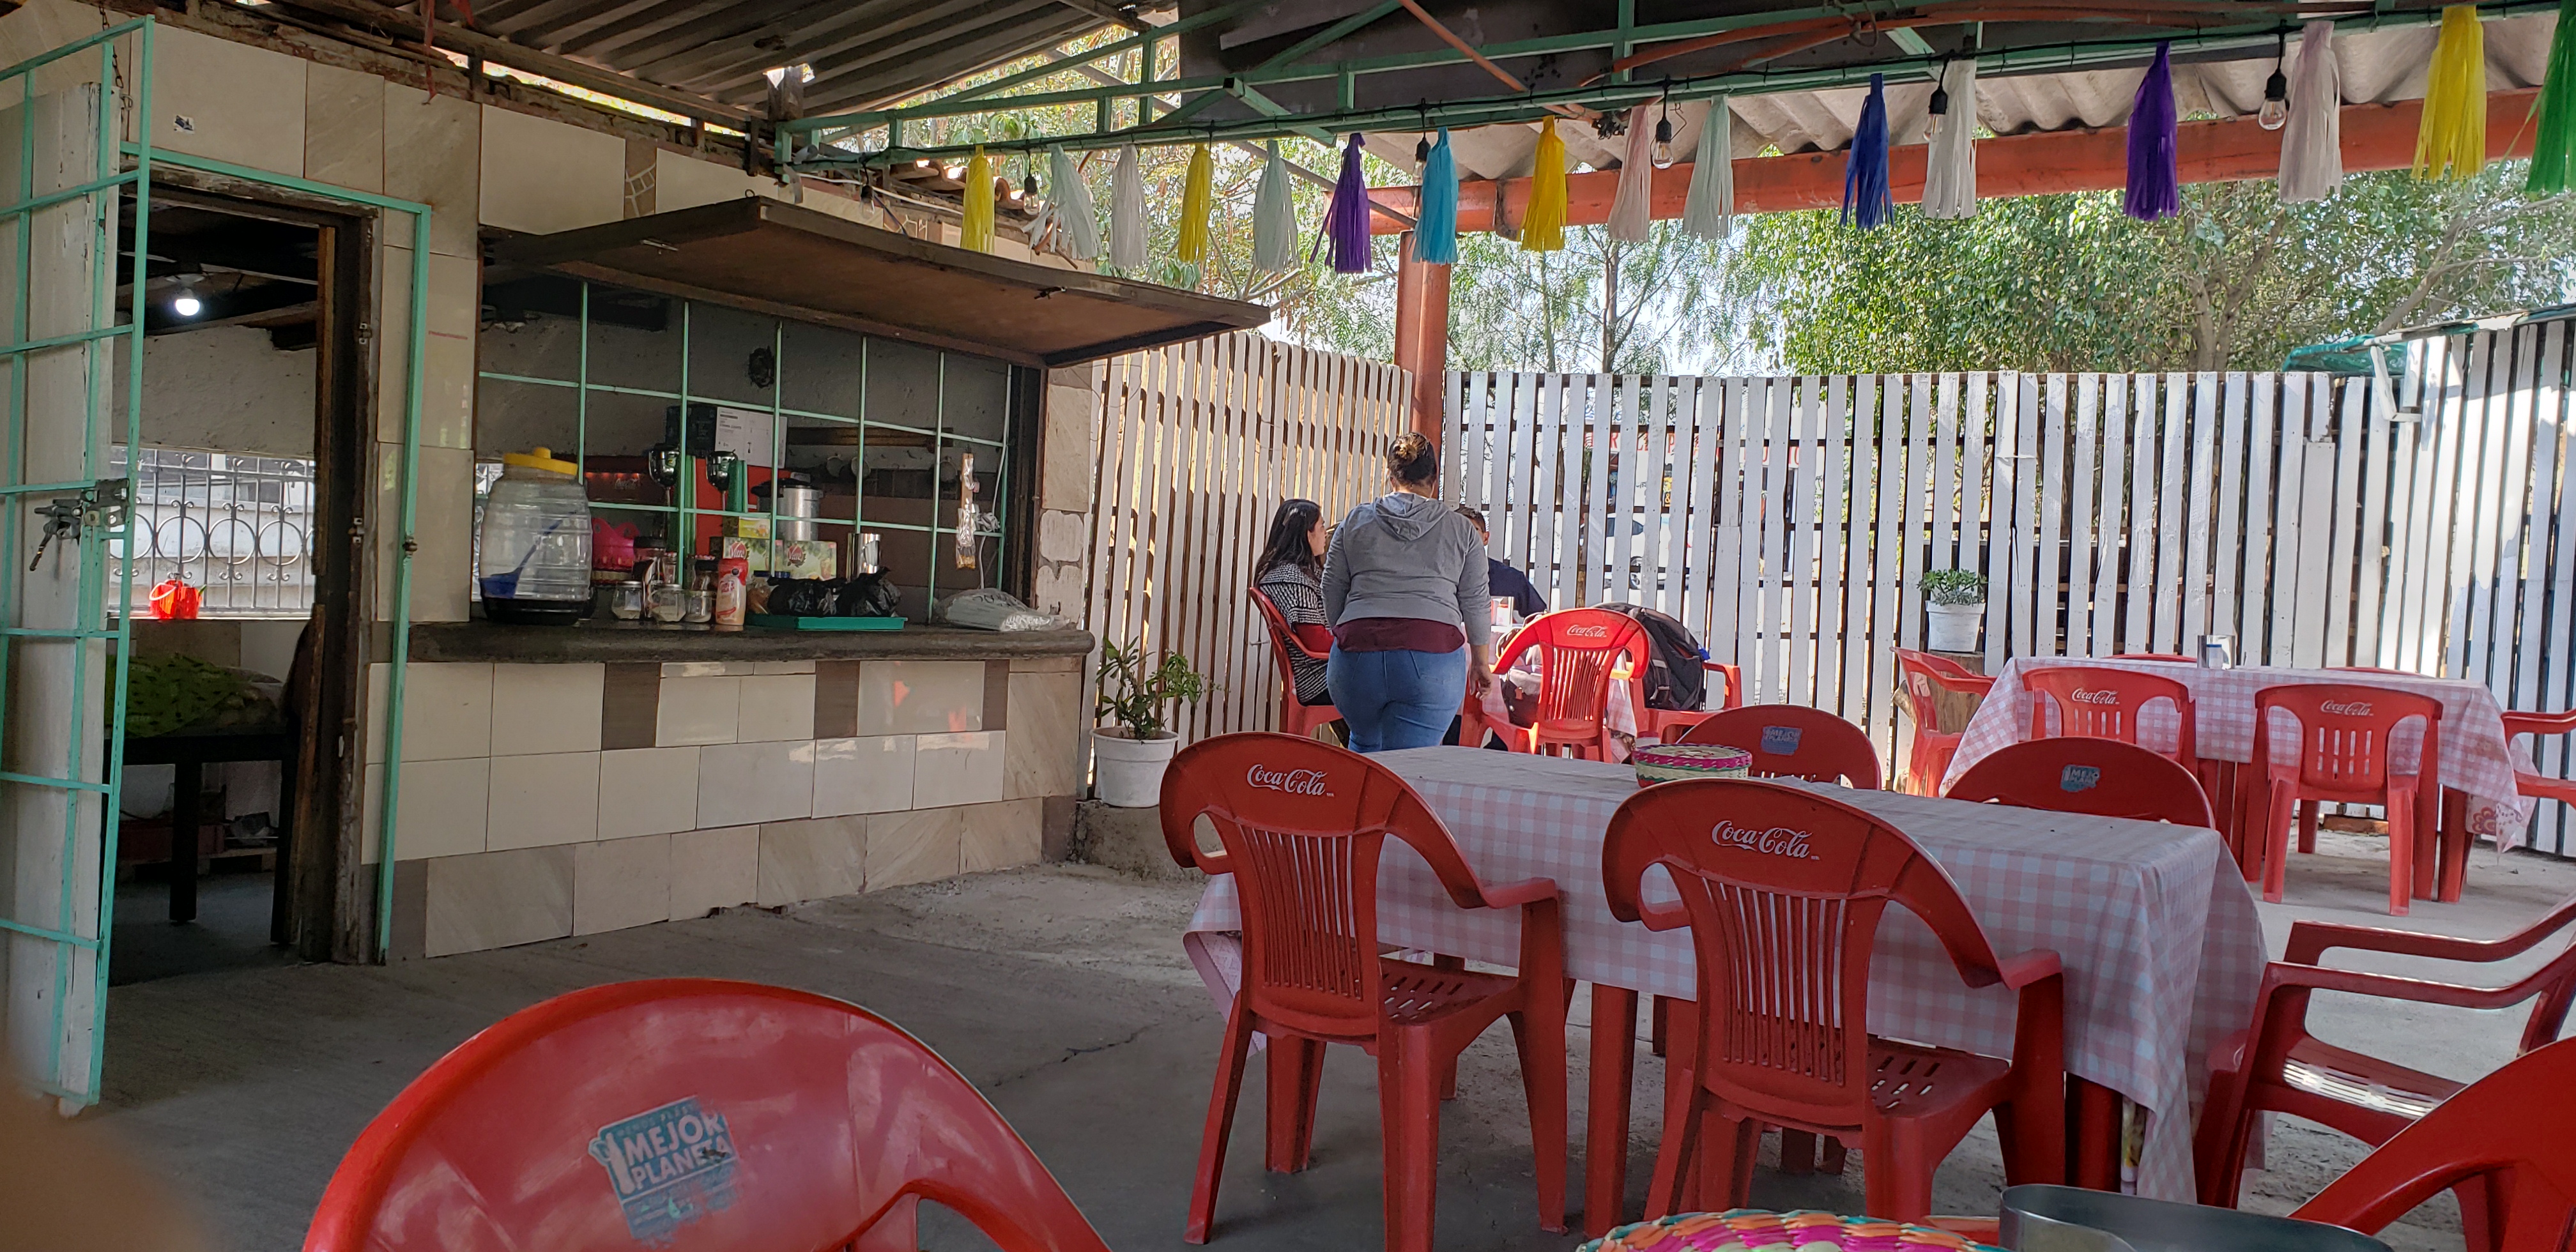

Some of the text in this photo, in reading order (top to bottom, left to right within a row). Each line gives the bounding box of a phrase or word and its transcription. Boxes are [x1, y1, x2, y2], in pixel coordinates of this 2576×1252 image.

[1567, 625, 1607, 637] Coca-Cola
[2071, 688, 2118, 704] Coca-Cola
[2320, 700, 2372, 715] Coca-Cola
[1247, 764, 1328, 795] Coca-Cola
[1712, 820, 1813, 858] Coca-Cola
[624, 1113, 724, 1166] MEJOR
[631, 1135, 733, 1190] PLANETA
